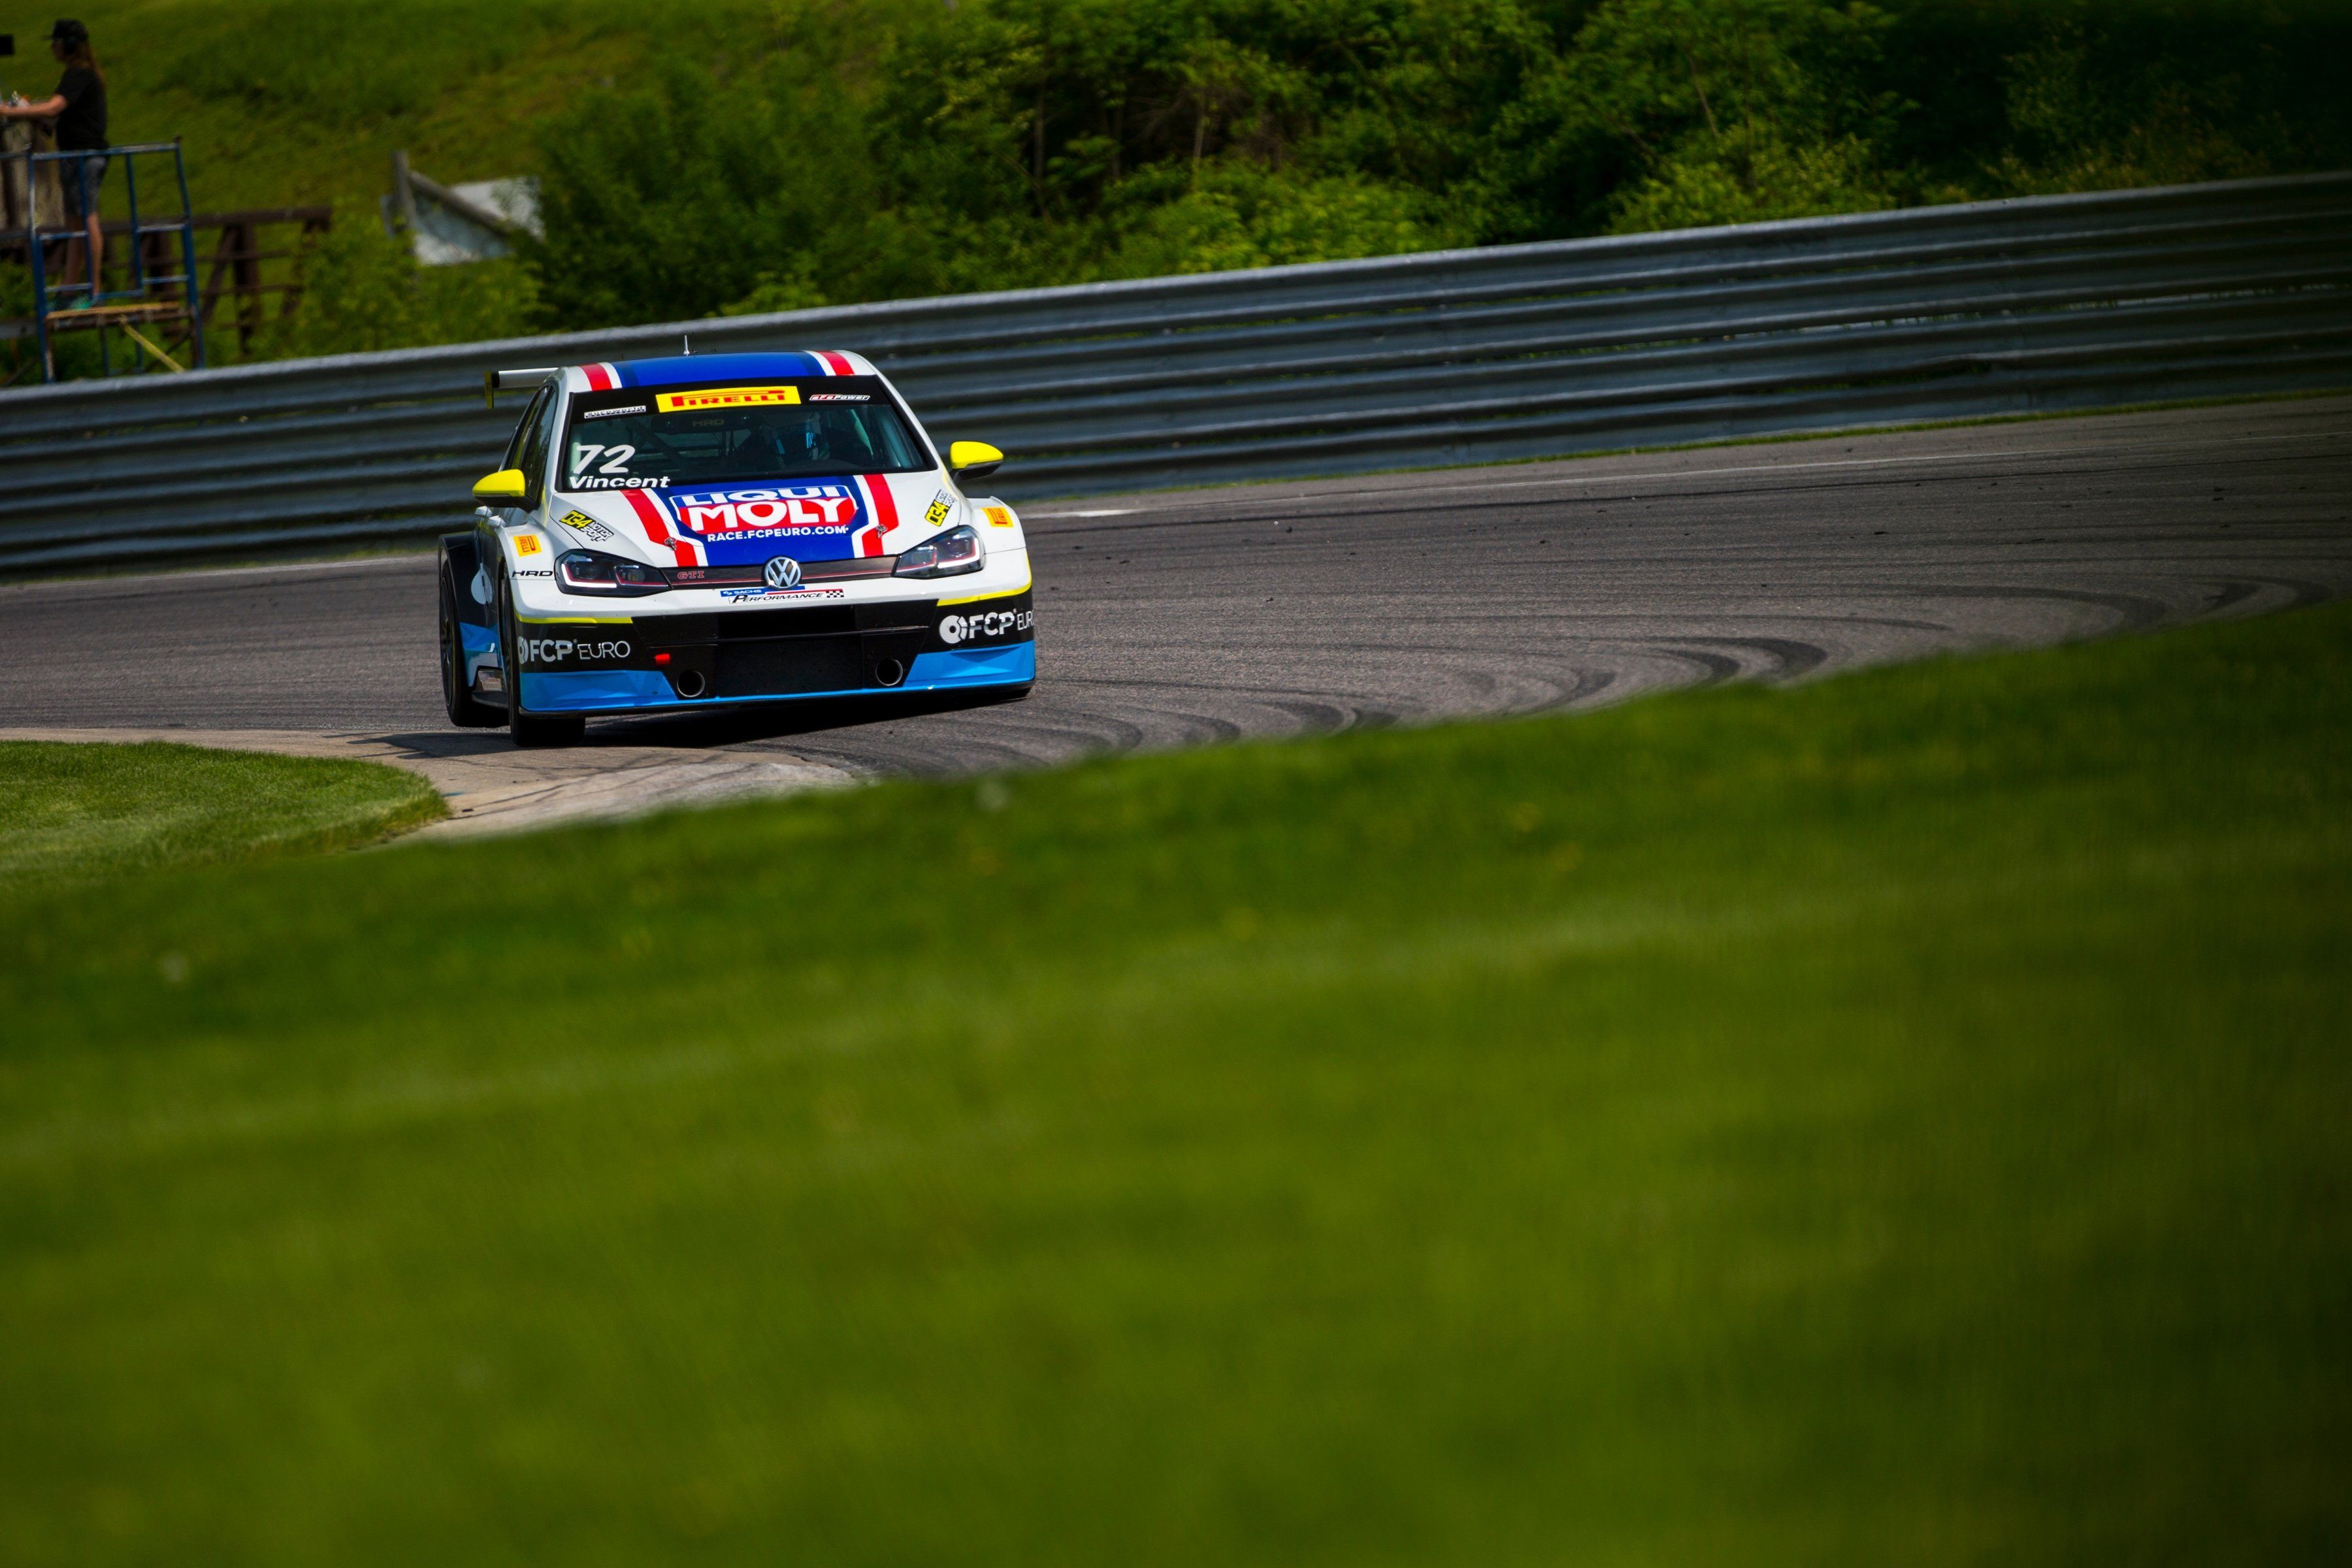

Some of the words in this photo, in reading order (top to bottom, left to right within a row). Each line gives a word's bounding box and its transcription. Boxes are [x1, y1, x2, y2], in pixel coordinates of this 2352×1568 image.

[671, 390, 785, 406] PIRELLI
[573, 444, 635, 474] 72
[570, 476, 670, 489] Vincent
[681, 487, 841, 506] LIQUI
[560, 510, 593, 529] 034
[687, 498, 849, 531] MOLY
[925, 500, 949, 527] 034
[708, 525, 846, 542] RACE.FCPEURO.COM
[677, 570, 704, 580] GTI
[732, 593, 823, 604] PERFORMANCE
[578, 640, 630, 660] EURO
